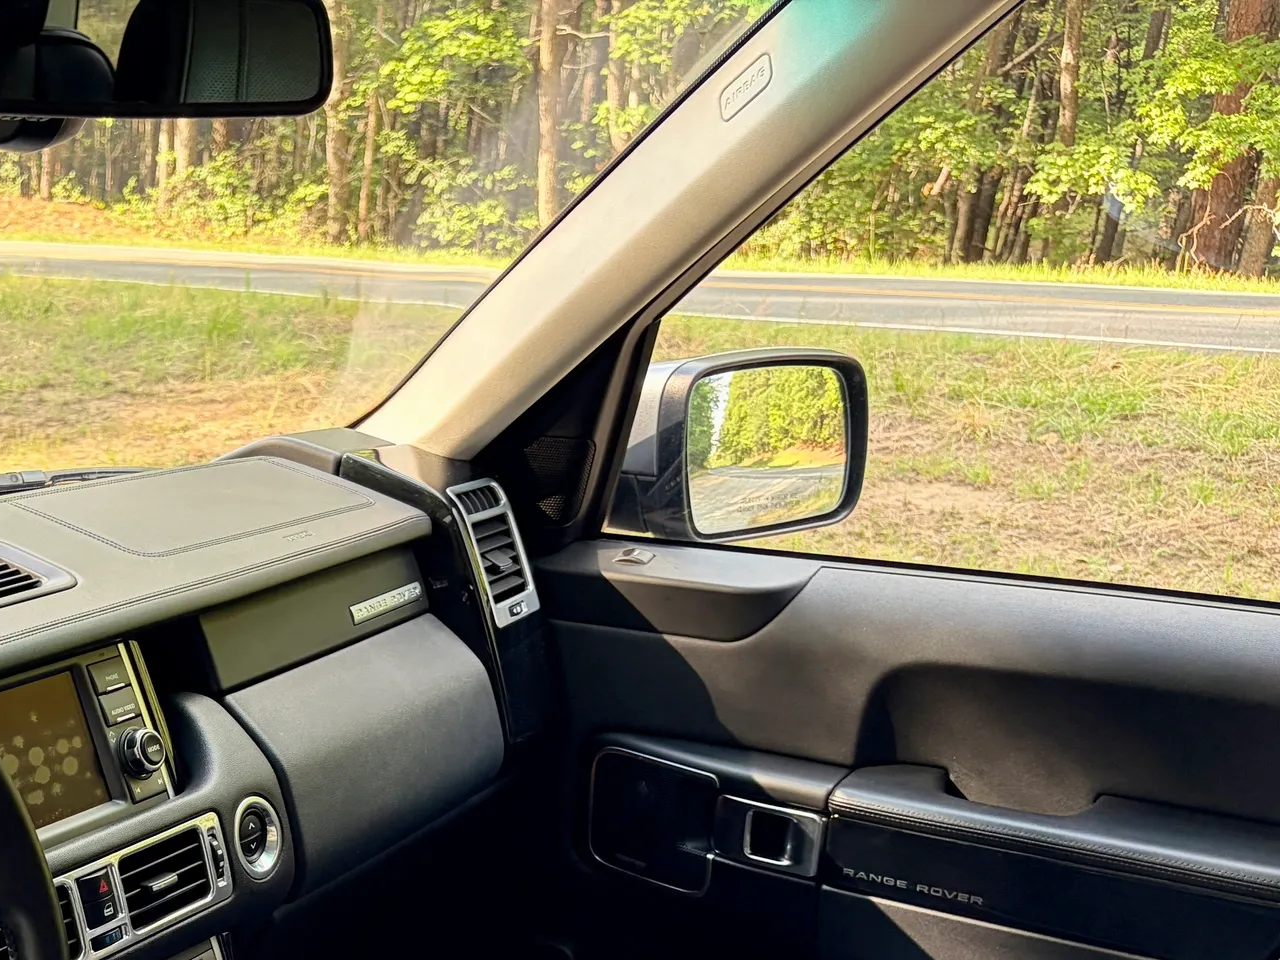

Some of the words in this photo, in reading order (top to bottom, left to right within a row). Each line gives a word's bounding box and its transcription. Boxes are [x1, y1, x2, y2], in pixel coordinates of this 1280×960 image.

[355, 597, 389, 618] RANGE
[147, 744, 161, 753] MODE
[843, 868, 908, 889] RANGE
[916, 884, 984, 906] ROVER
